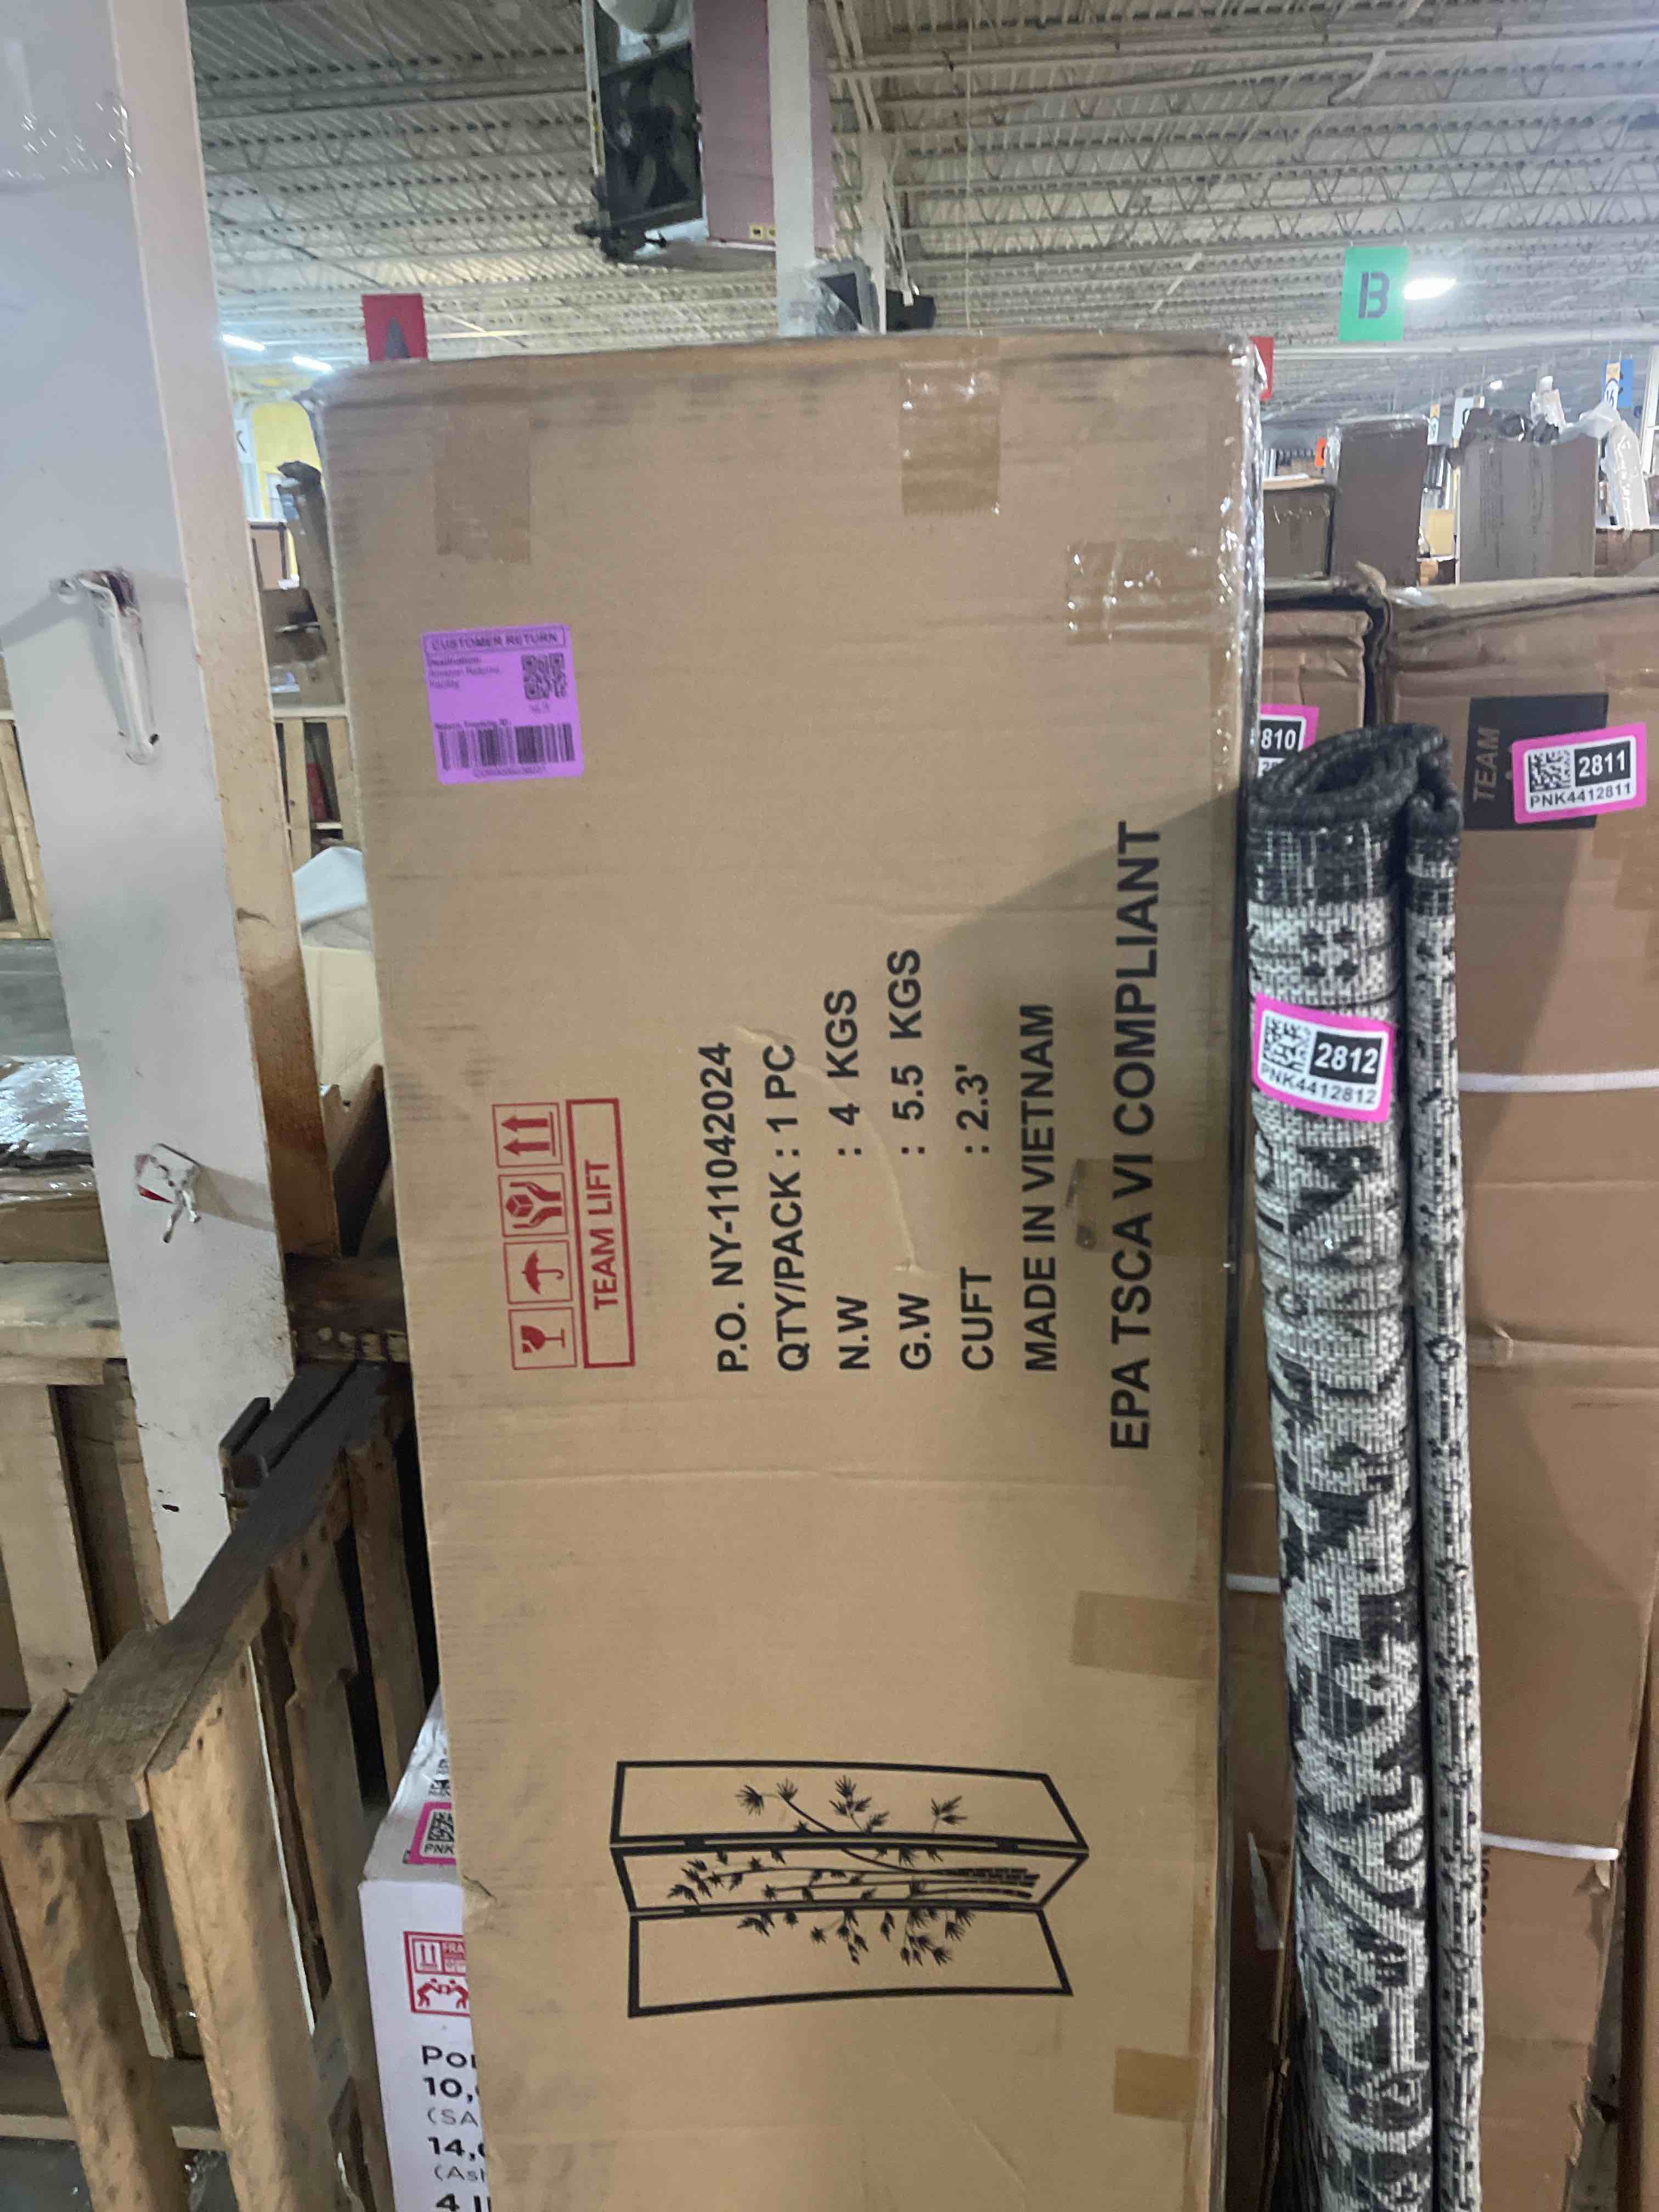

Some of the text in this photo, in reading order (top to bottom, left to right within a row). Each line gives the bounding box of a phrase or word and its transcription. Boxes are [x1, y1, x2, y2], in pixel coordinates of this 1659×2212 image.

[1358, 272, 1390, 319] B
[1261, 727, 1296, 751] 810
[1474, 727, 1500, 802] TEAM
[1578, 749, 1625, 778] 2811
[1530, 783, 1631, 808] PNK4412811
[887, 950, 922, 1039] KGS
[824, 990, 859, 1077] KGS
[1314, 1042, 1379, 1074] 2812
[763, 1045, 797, 1099] PC
[891, 1065, 924, 1120] 5.5
[955, 1065, 989, 1131] 2.3'
[1261, 1063, 1377, 1104] PNK4412812
[828, 1103, 860, 1126] 4
[1111, 821, 1160, 1448] EPA TSCA VI COMPLIANT
[698, 1042, 748, 1372] P.O. NY-11042024
[1020, 1006, 1056, 1370] MADE IN VIETNAM
[584, 1159, 619, 1310] TEAM LIFT
[769, 1172, 810, 1371] QTY/PACK
[836, 1296, 870, 1369] N.W
[898, 1293, 931, 1369] G.W
[960, 1266, 994, 1370] CUFT
[423, 2076, 479, 2103] 10,
